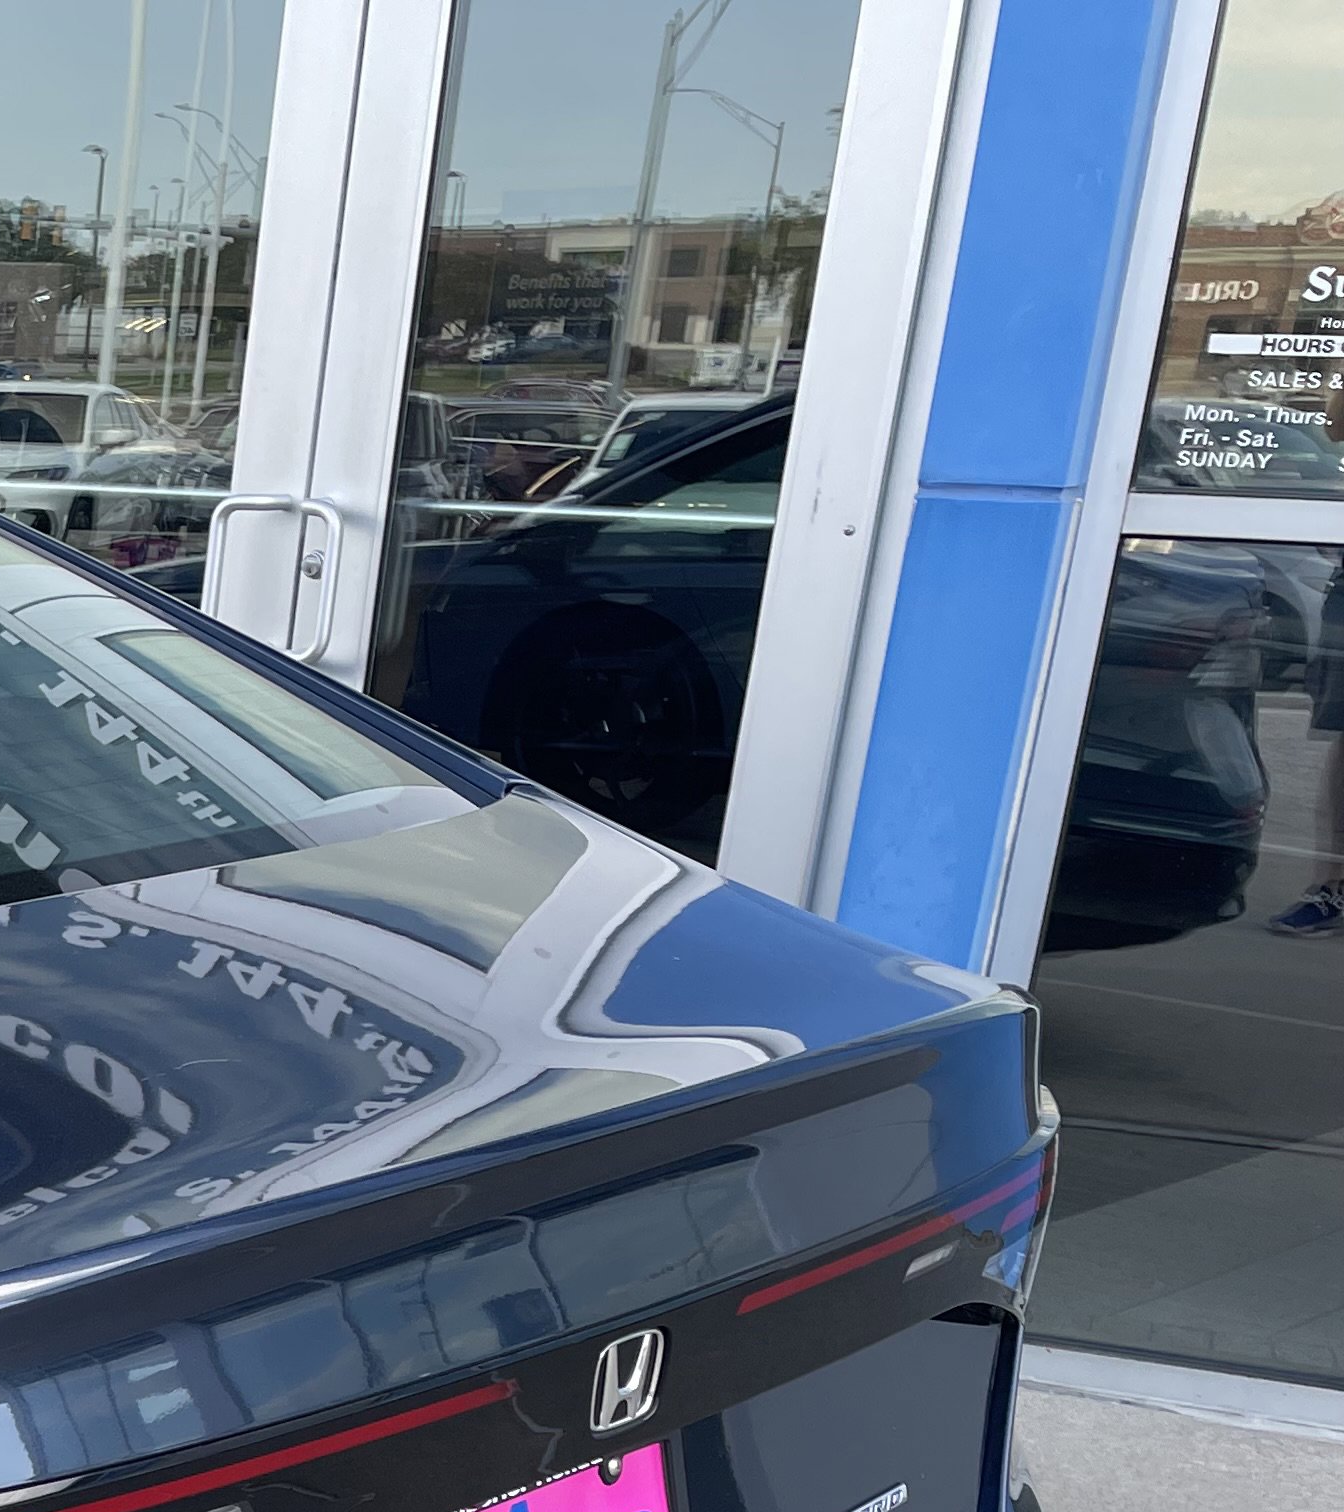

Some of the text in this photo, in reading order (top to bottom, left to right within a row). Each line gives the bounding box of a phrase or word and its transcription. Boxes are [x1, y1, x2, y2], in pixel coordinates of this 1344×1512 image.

[507, 271, 608, 291] Benefits that
[505, 293, 604, 312] work for you
[1262, 337, 1336, 353] HOURS
[1247, 371, 1344, 389] SALES &
[1184, 404, 1240, 423] Mon.
[1262, 406, 1333, 426] Thurs.
[1179, 428, 1214, 446] Fri.
[1235, 429, 1280, 448] Sat.
[1176, 451, 1273, 470] SUNDAY
